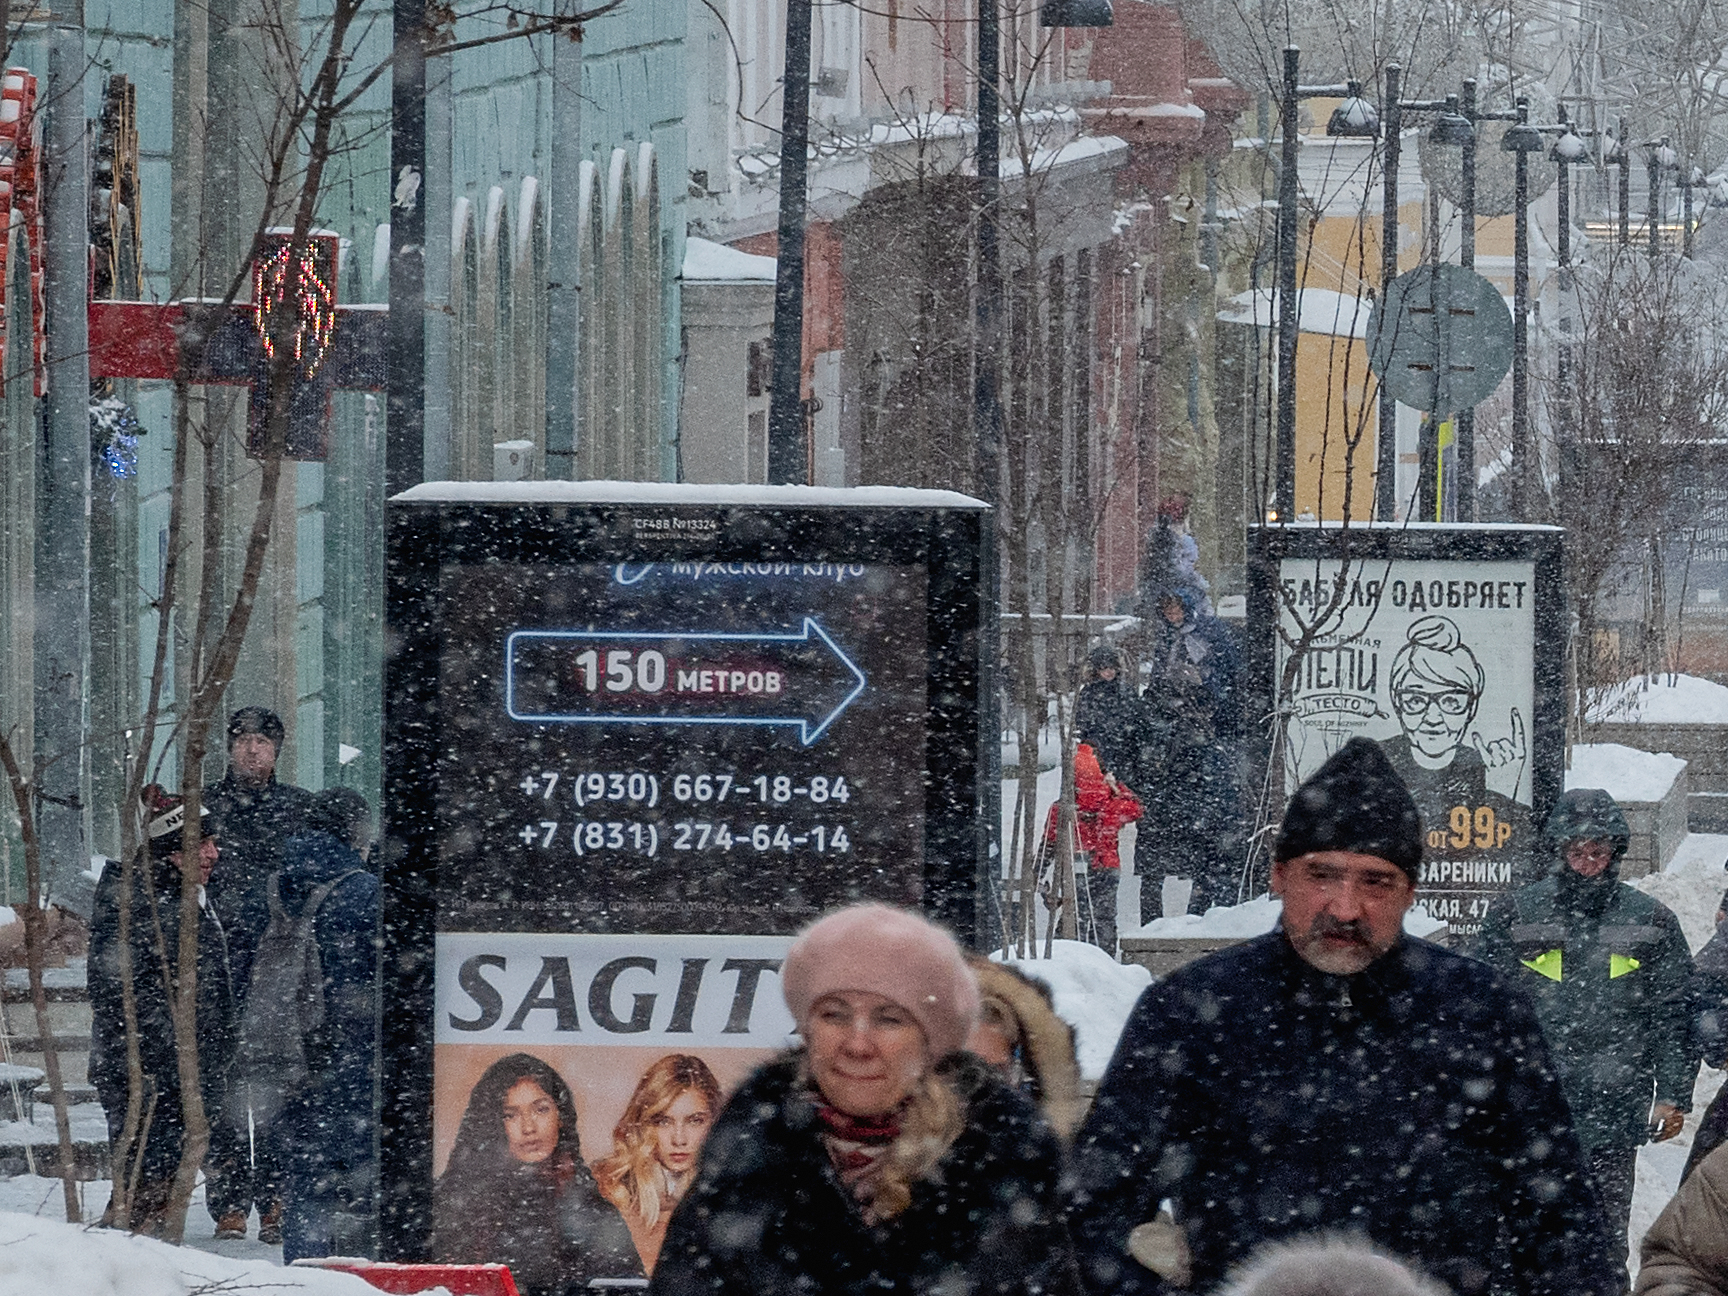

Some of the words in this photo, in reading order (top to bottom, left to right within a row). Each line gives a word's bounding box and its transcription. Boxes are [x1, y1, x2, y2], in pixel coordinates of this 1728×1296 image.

[1283, 577, 1381, 608] БАБЛЯ
[1392, 580, 1528, 613] ОДОБРЯЕТ
[575, 649, 665, 692] 150
[676, 670, 782, 693] МЕТРОВ
[1313, 696, 1361, 710] ТЕСТО
[519, 772, 560, 800] +7
[574, 773, 659, 808] (930)
[673, 773, 851, 804] 667-18-84
[518, 821, 558, 849] +7
[573, 822, 659, 857] (831)
[673, 822, 851, 853] 274-64-14
[1428, 830, 1448, 849] ОТ
[1469, 898, 1489, 918] 47
[448, 954, 800, 1035] SAGIT
